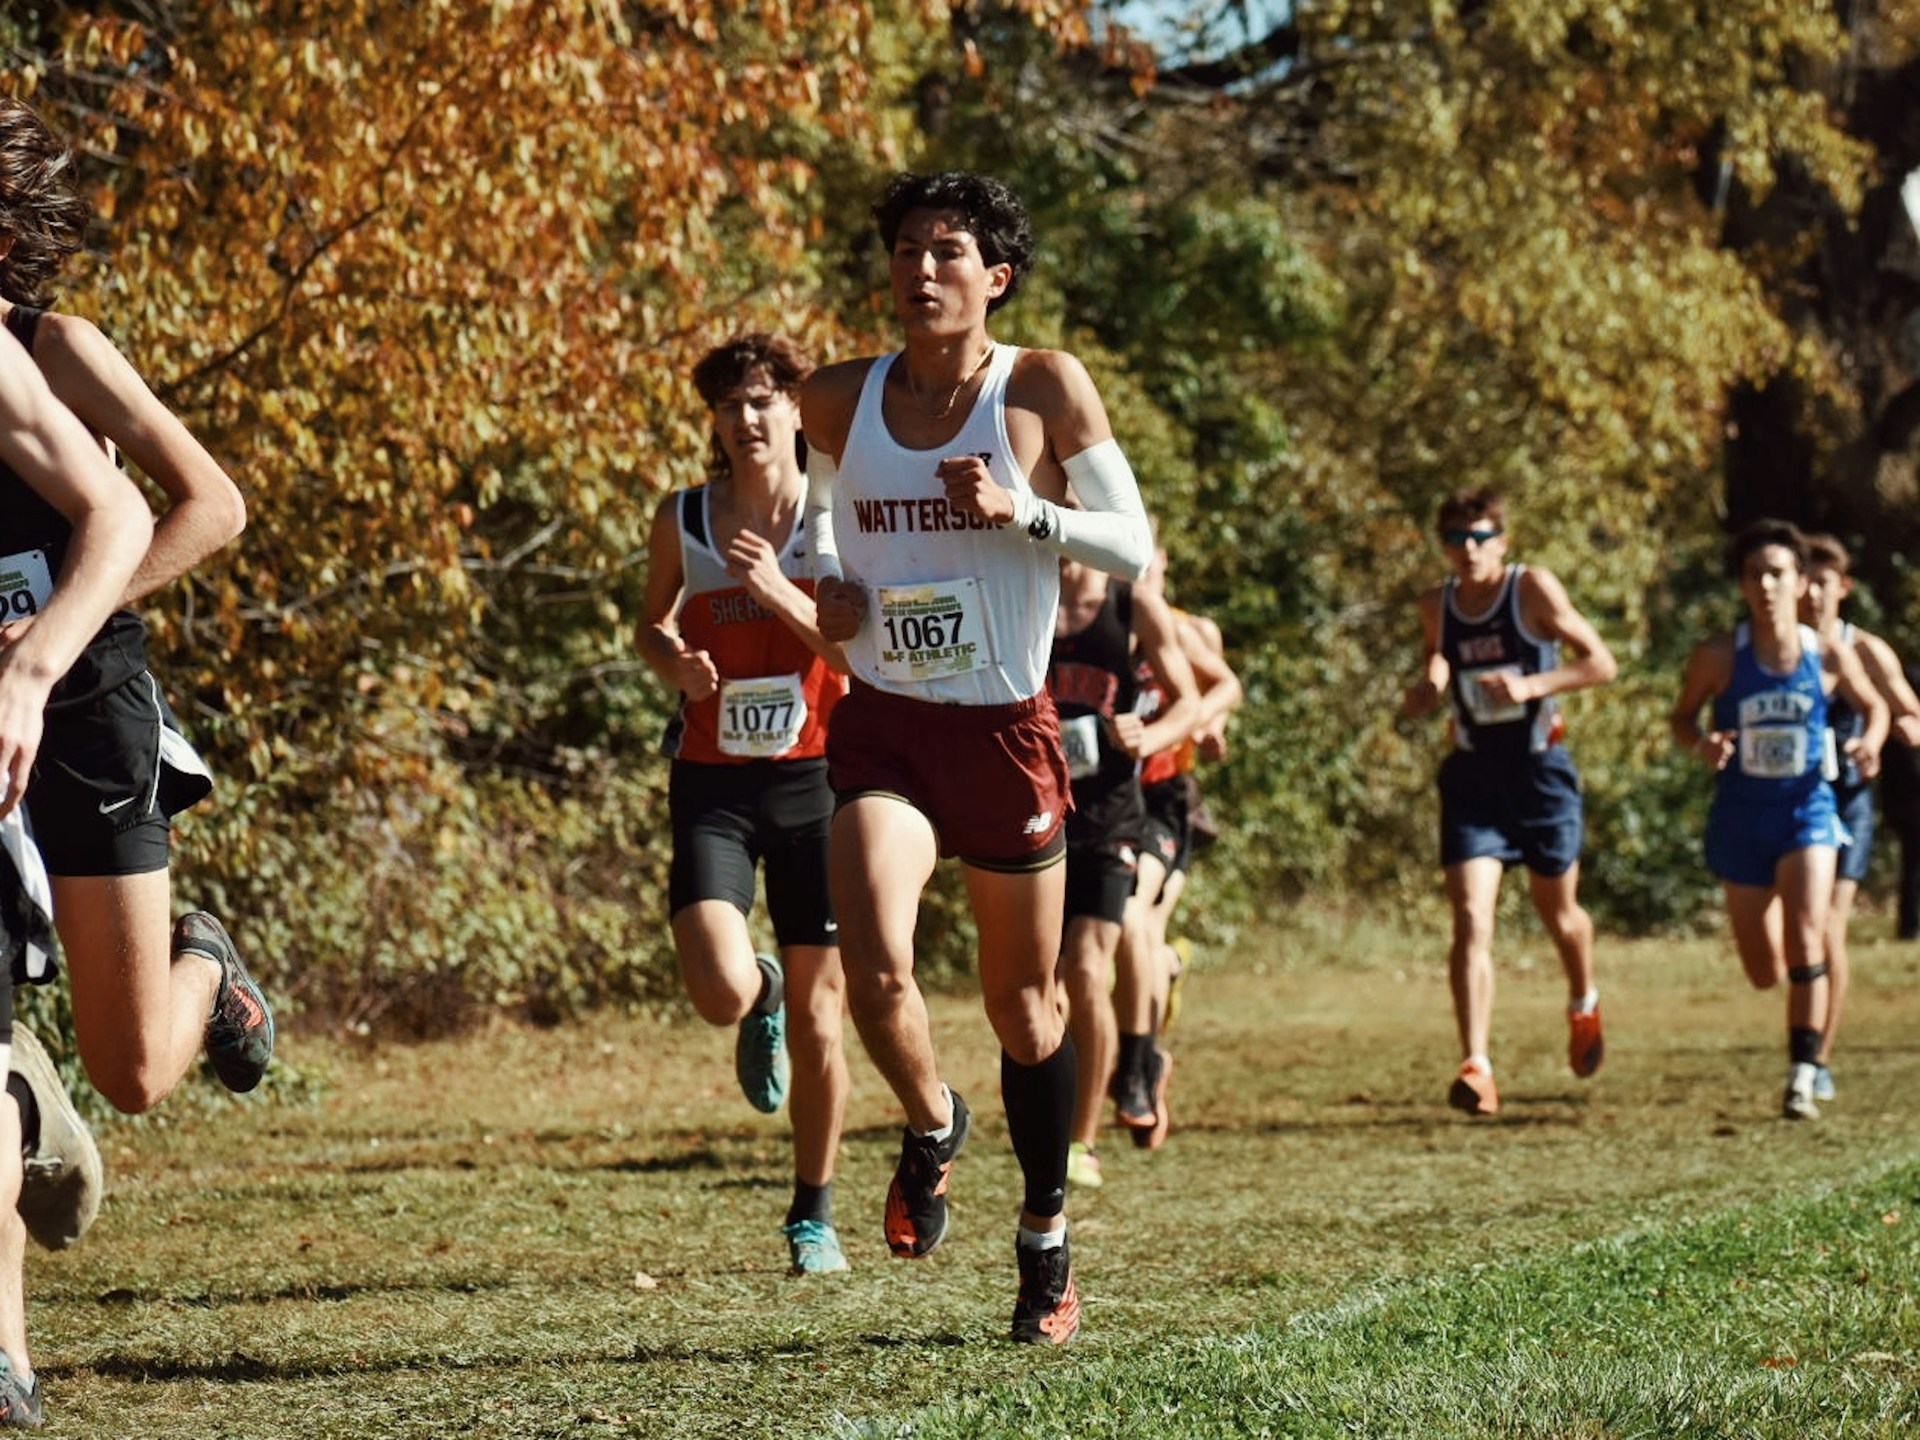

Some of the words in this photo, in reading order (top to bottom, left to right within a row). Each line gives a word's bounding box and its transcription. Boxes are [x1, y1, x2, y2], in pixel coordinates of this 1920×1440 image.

[854, 497, 1004, 533] WATTERS
[884, 611, 964, 651] 1067
[909, 642, 977, 663] ATHLETIC
[726, 702, 795, 732] 1077
